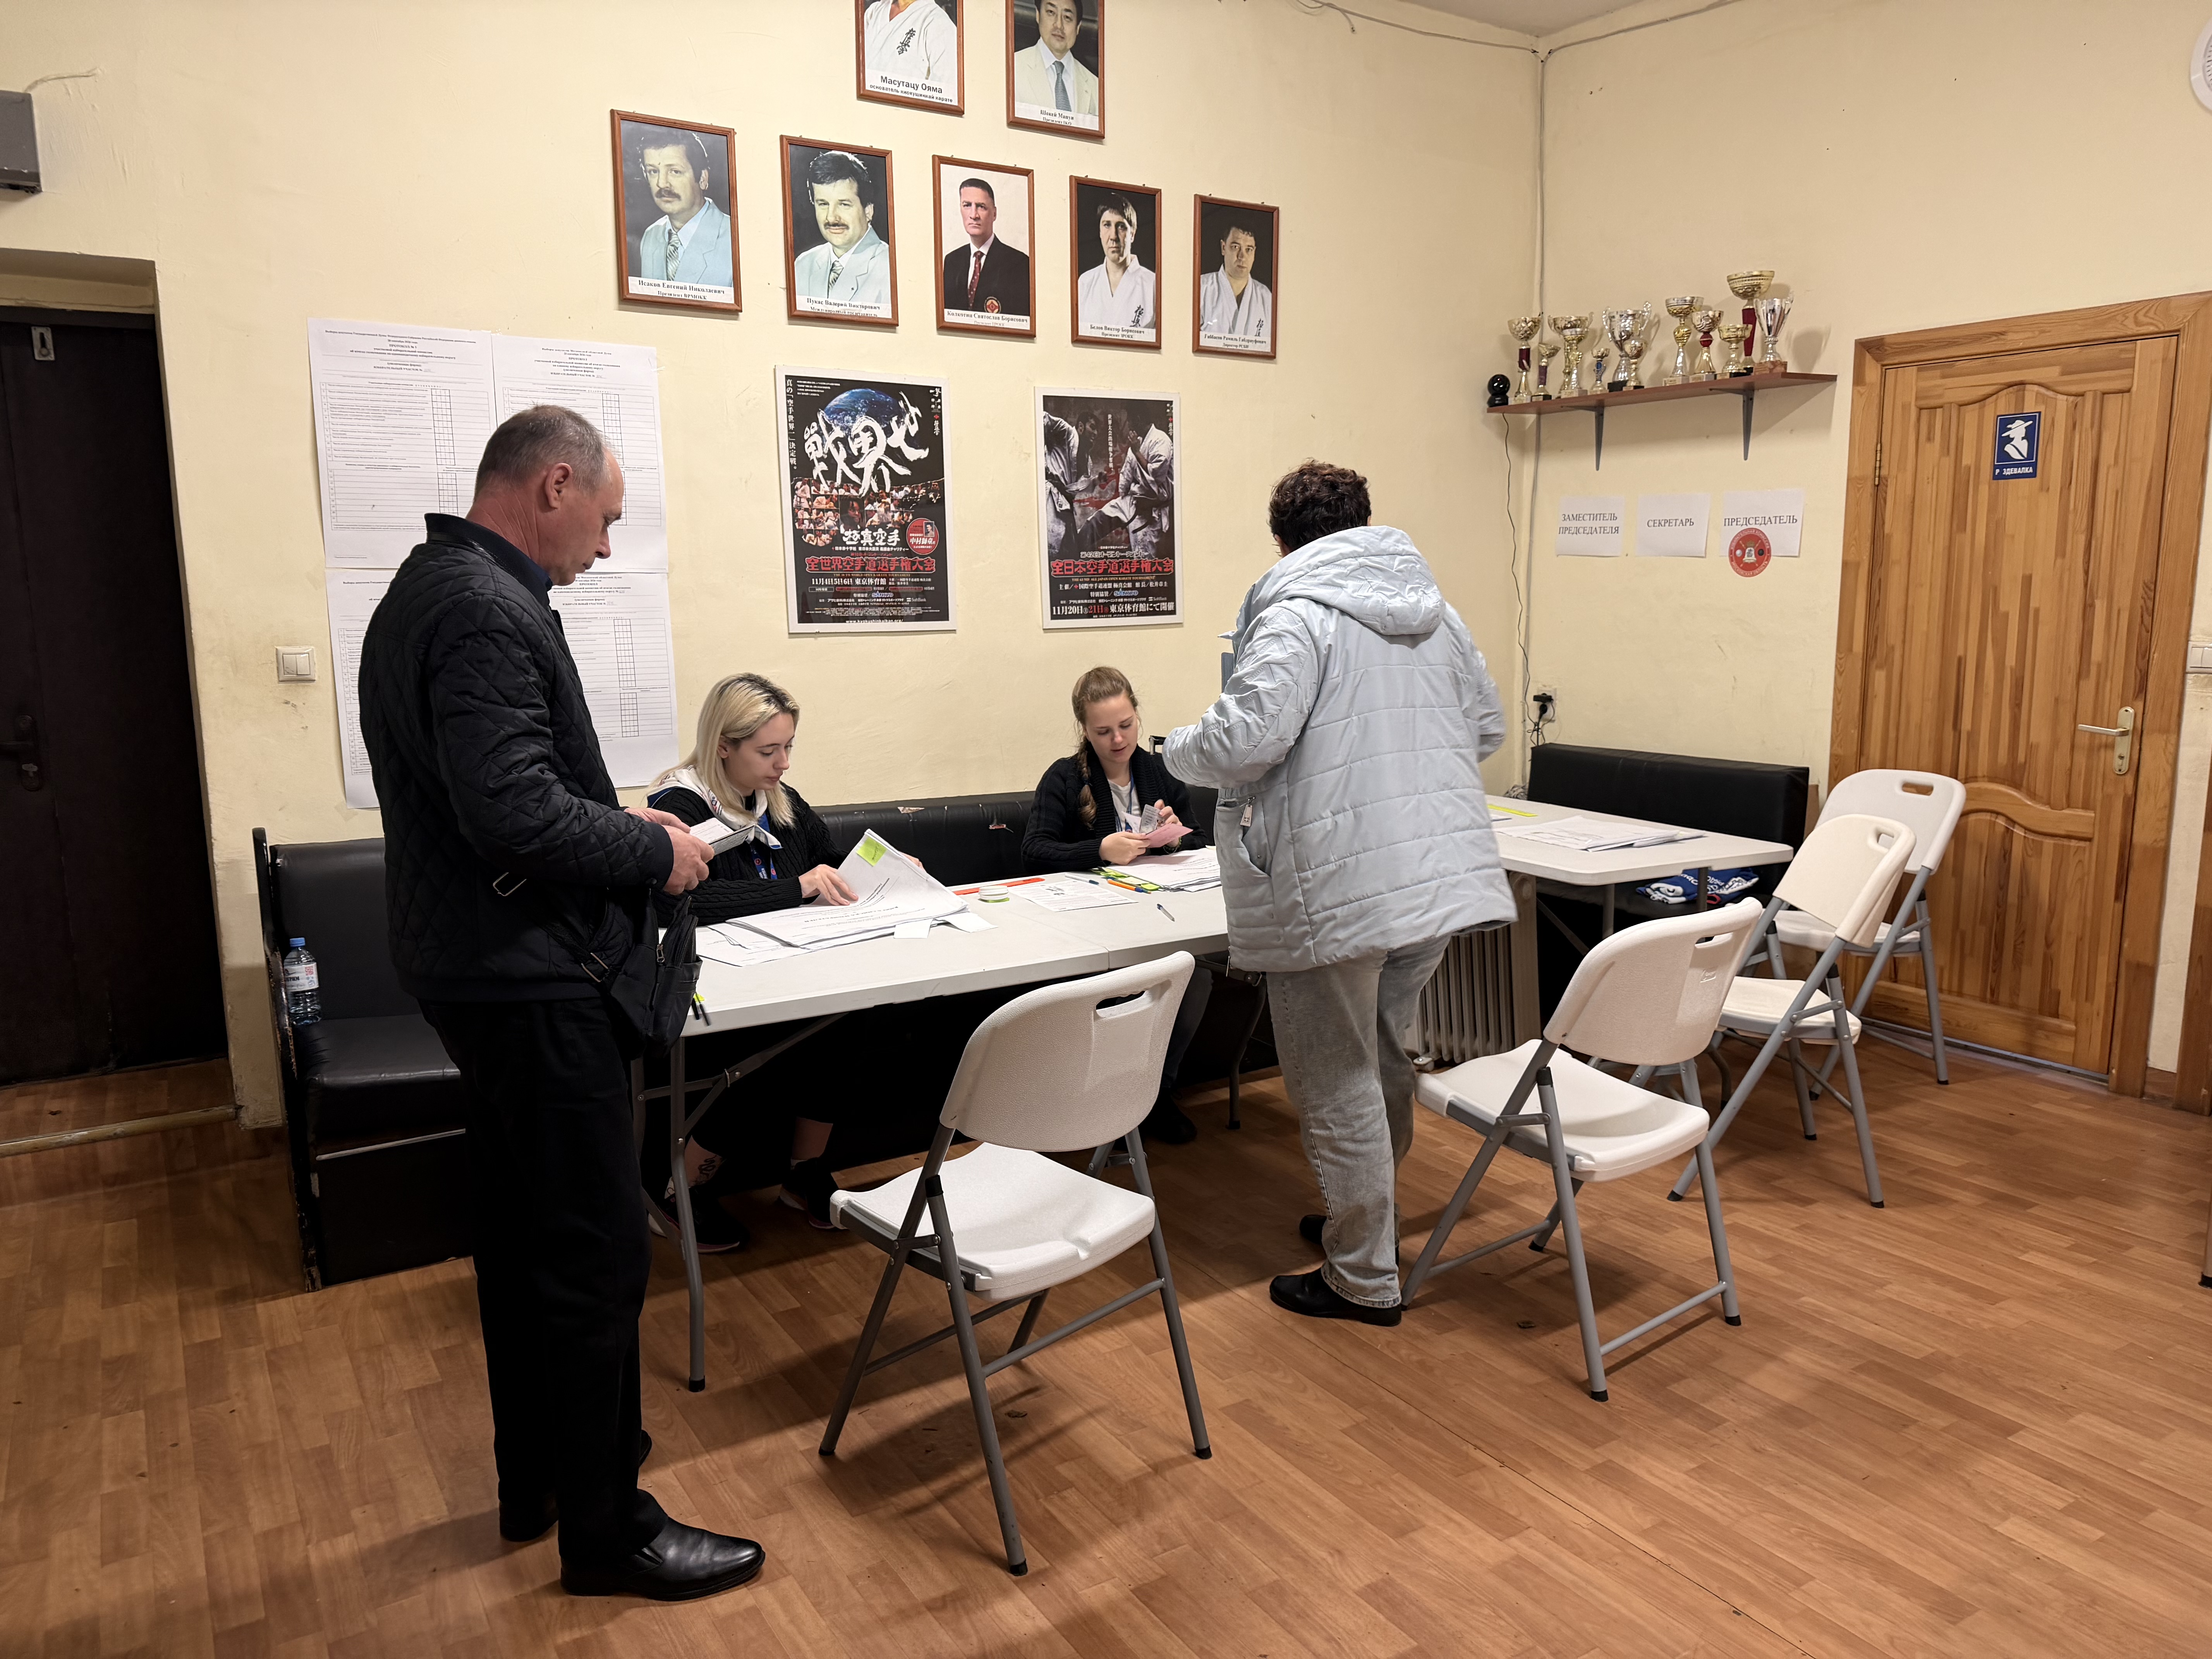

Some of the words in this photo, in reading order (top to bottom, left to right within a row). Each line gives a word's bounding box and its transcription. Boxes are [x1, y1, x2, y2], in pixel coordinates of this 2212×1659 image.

[870, 84, 900, 93] основатель
[881, 76, 919, 91] Масутацу
[921, 83, 943, 94] Ояма
[662, 282, 687, 290] Евгений
[689, 285, 725, 294] Николаевич
[1561, 513, 1618, 522] ЗАМЕСТИТЕЛЬ
[1647, 518, 1694, 528] СЕКРЕТАРЬ
[1723, 515, 1798, 527] ПРЕДСЕДАТЕЛЬ
[1558, 526, 1620, 535] ПРЕДСЕДАТЕЛЯ
[842, 528, 900, 546] 極真空手
[806, 556, 935, 572] 全世界空手道選手権大会
[1051, 559, 1174, 575] 全日本空手道選手権大会
